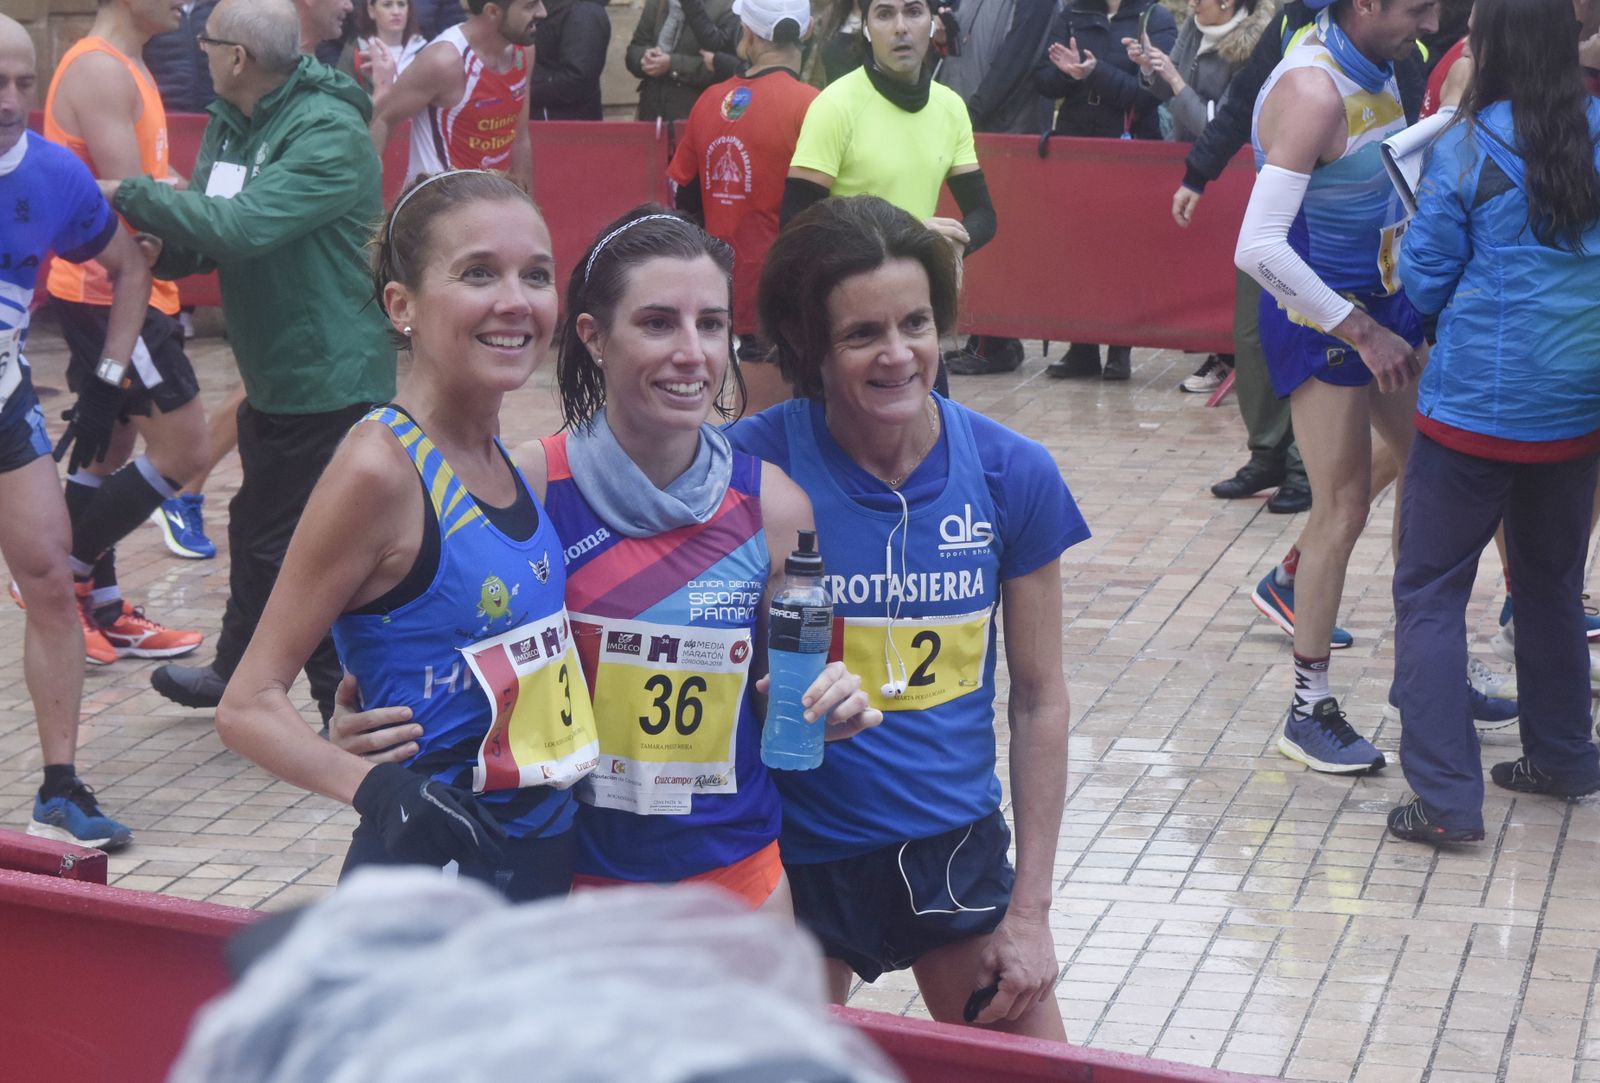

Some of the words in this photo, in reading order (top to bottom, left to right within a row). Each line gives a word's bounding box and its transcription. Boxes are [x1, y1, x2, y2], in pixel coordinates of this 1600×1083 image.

[939, 503, 994, 546] als
[940, 551, 967, 559] sport
[821, 567, 985, 604] TROTASIERRA
[689, 591, 760, 605] SEOANE
[607, 642, 641, 653] IMDECO
[696, 640, 726, 650] MEDIA
[514, 648, 540, 663] IMDECO
[682, 649, 724, 661] MARATÓN
[907, 629, 942, 688] 2
[558, 663, 573, 727] 3
[638, 673, 708, 736] 36
[654, 775, 694, 787] Cruzcampo
